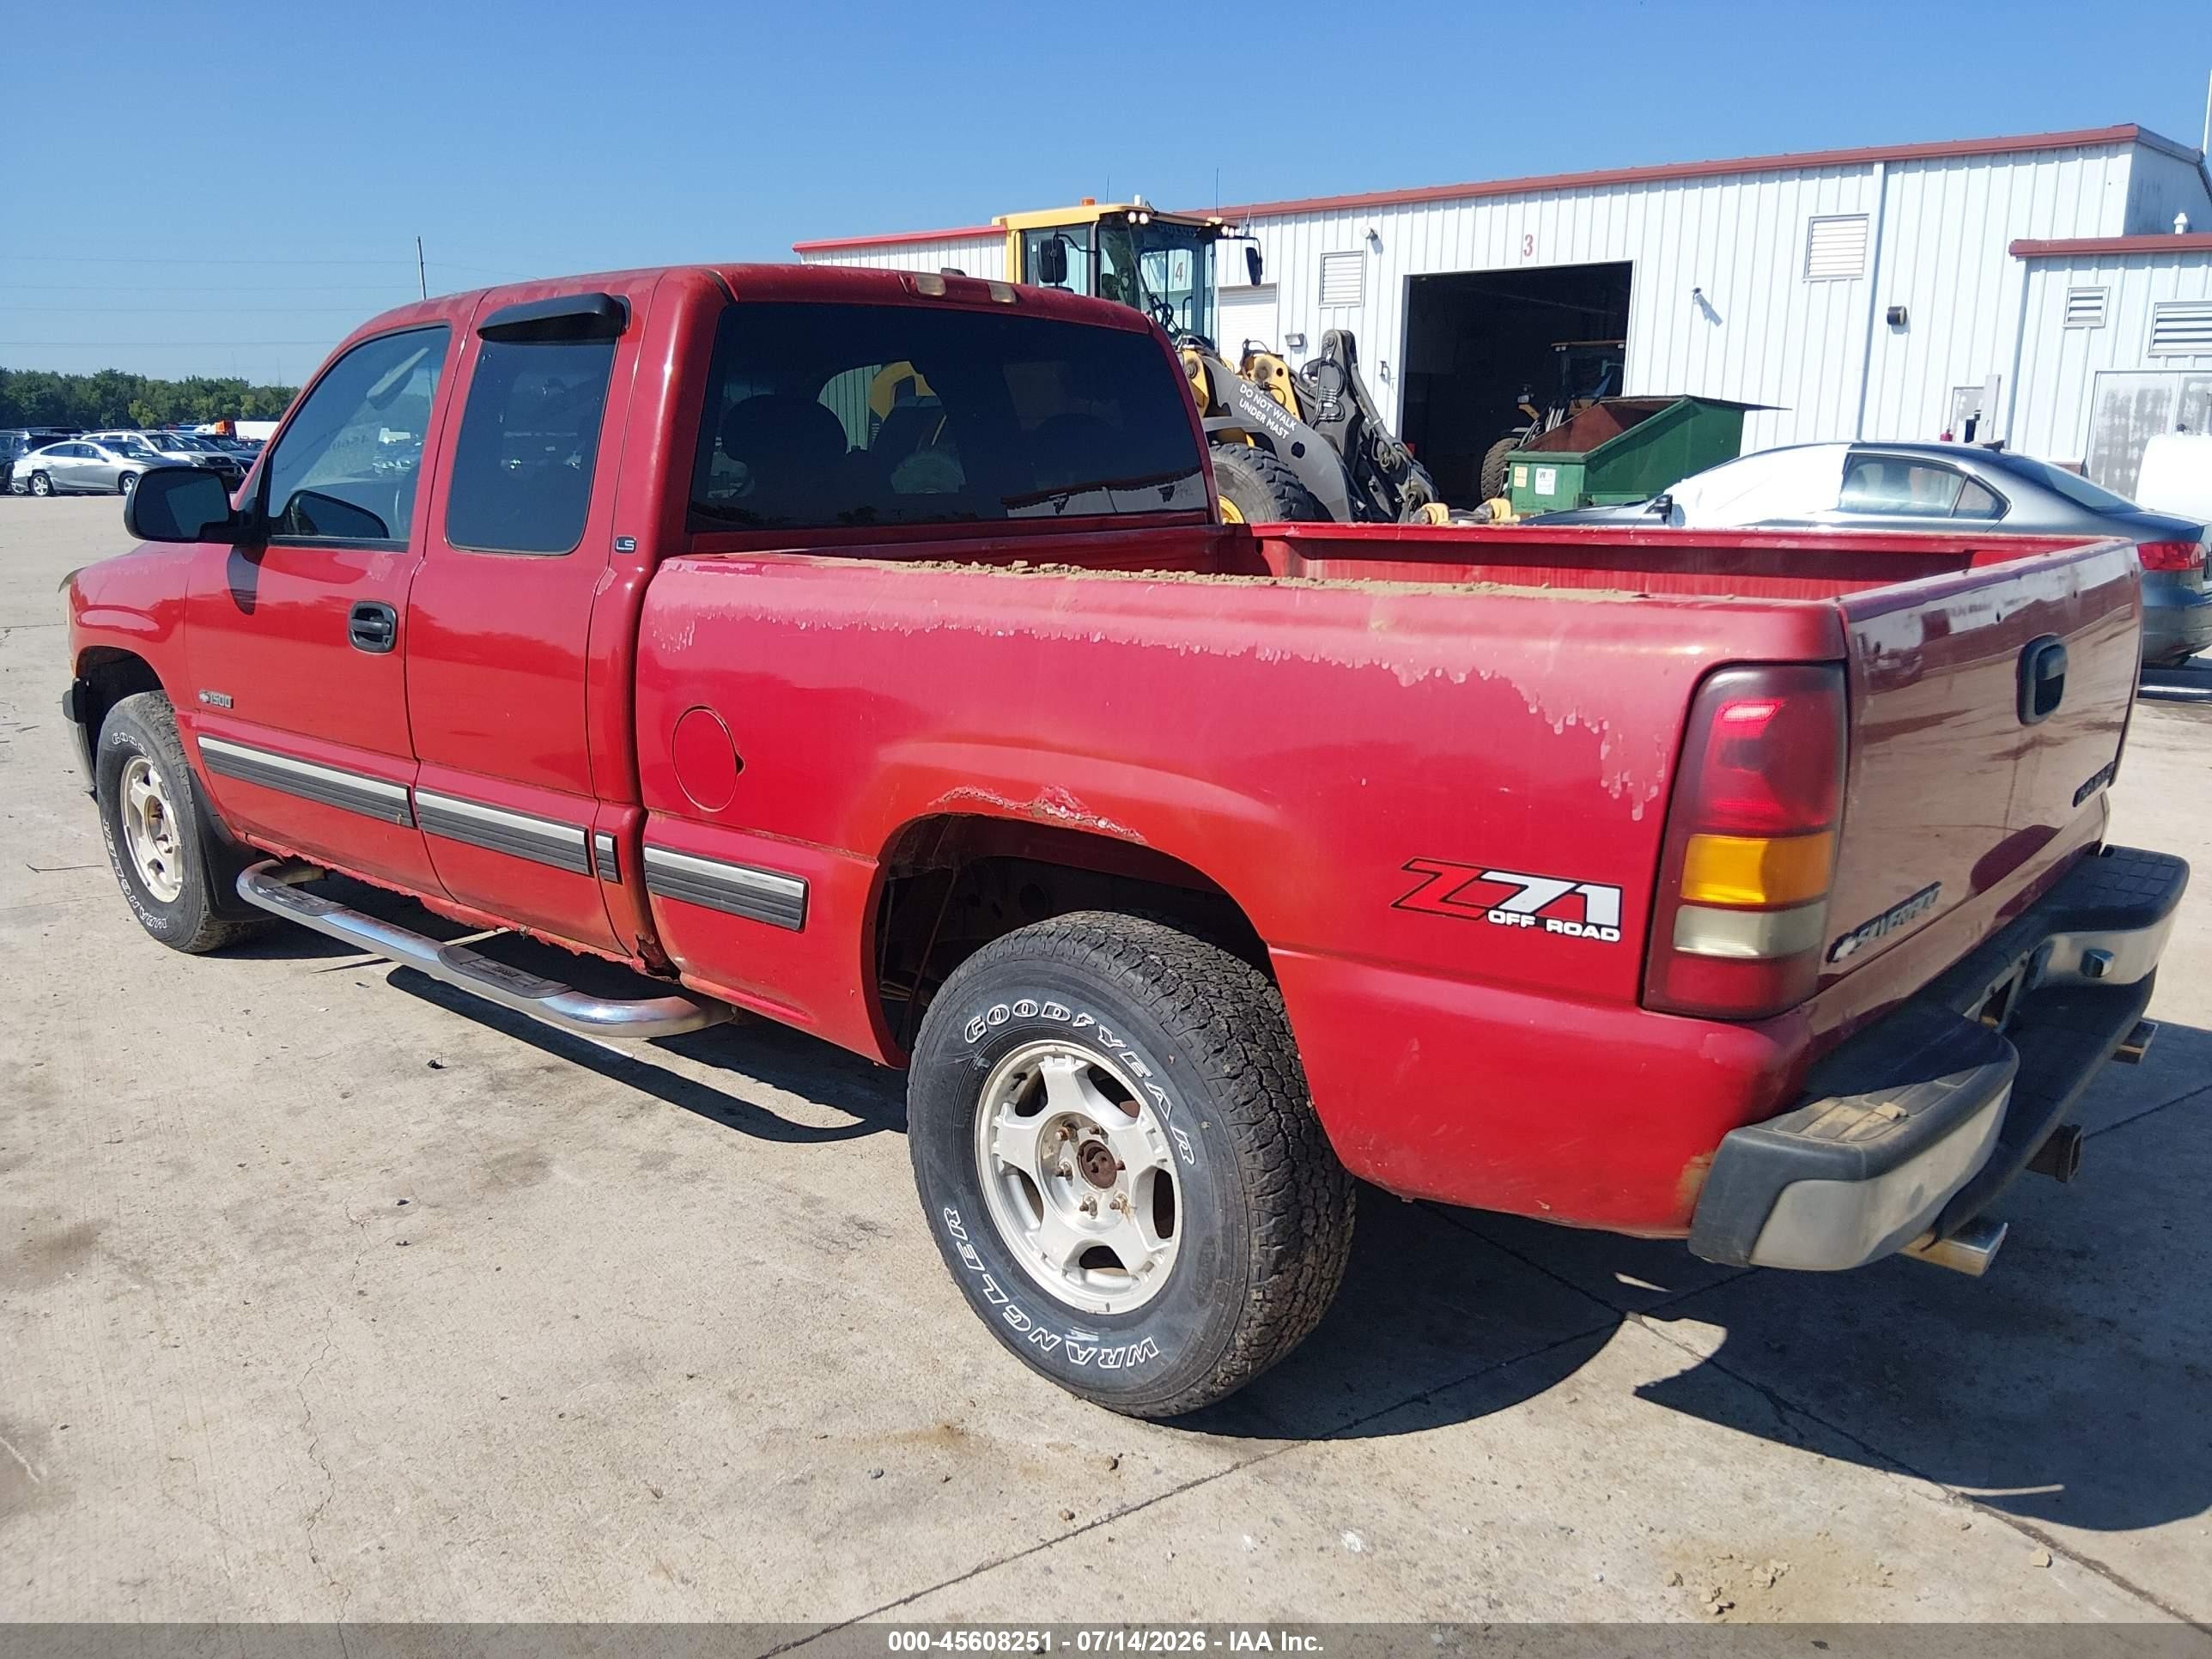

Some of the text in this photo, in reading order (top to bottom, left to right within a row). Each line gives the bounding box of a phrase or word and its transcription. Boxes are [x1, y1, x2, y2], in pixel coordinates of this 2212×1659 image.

[1523, 234, 1534, 257] 3
[1175, 262, 1183, 282] 4
[1239, 383, 1297, 431] DO NOT WALK
[1239, 398, 1290, 439] UNDER MAST
[616, 539, 635, 550] LS
[1390, 857, 1623, 927] Z71
[1487, 908, 1620, 943] OFF ROAD
[964, 999, 1195, 1165] GOODYEAR
[944, 1206, 1159, 1369] WRANGLER
